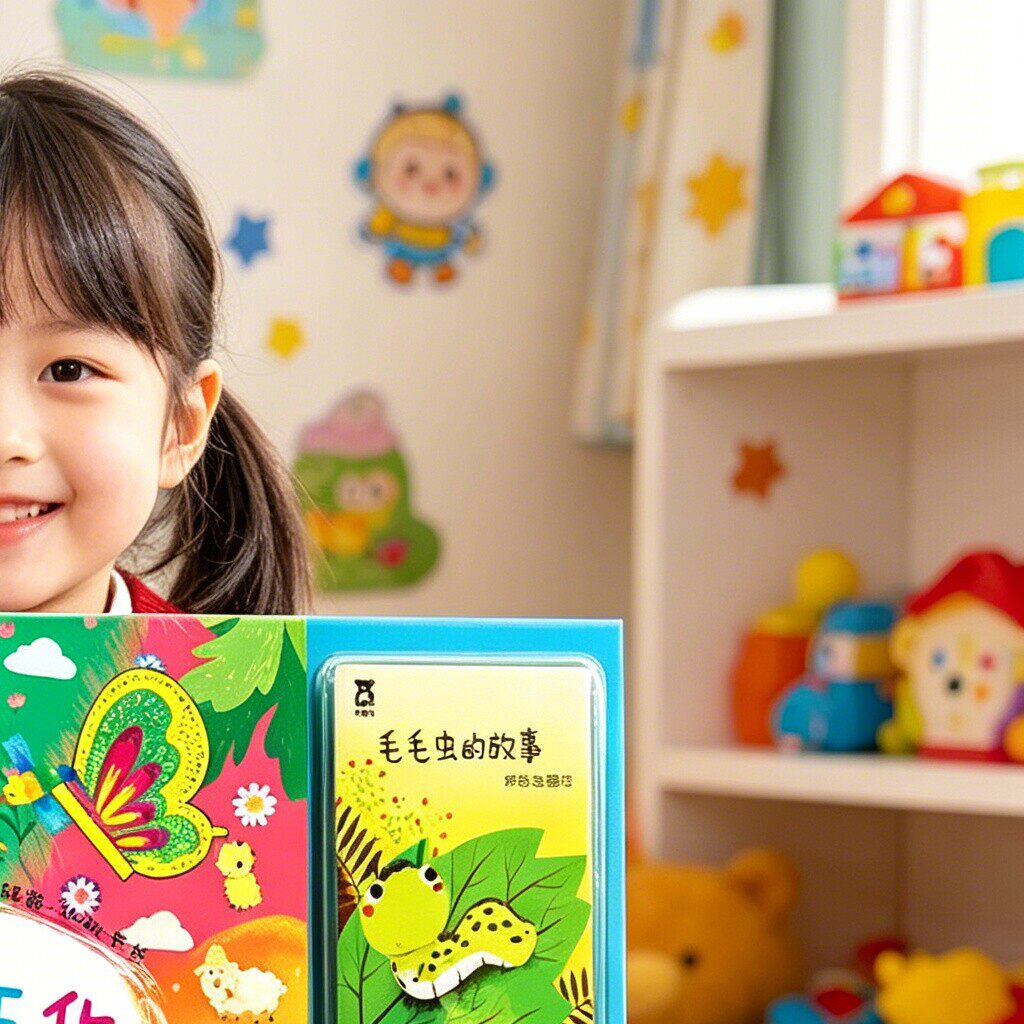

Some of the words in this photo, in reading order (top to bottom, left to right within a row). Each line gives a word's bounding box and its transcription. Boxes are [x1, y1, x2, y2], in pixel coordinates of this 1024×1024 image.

[379, 727, 542, 764] 毛毛虫的故事
